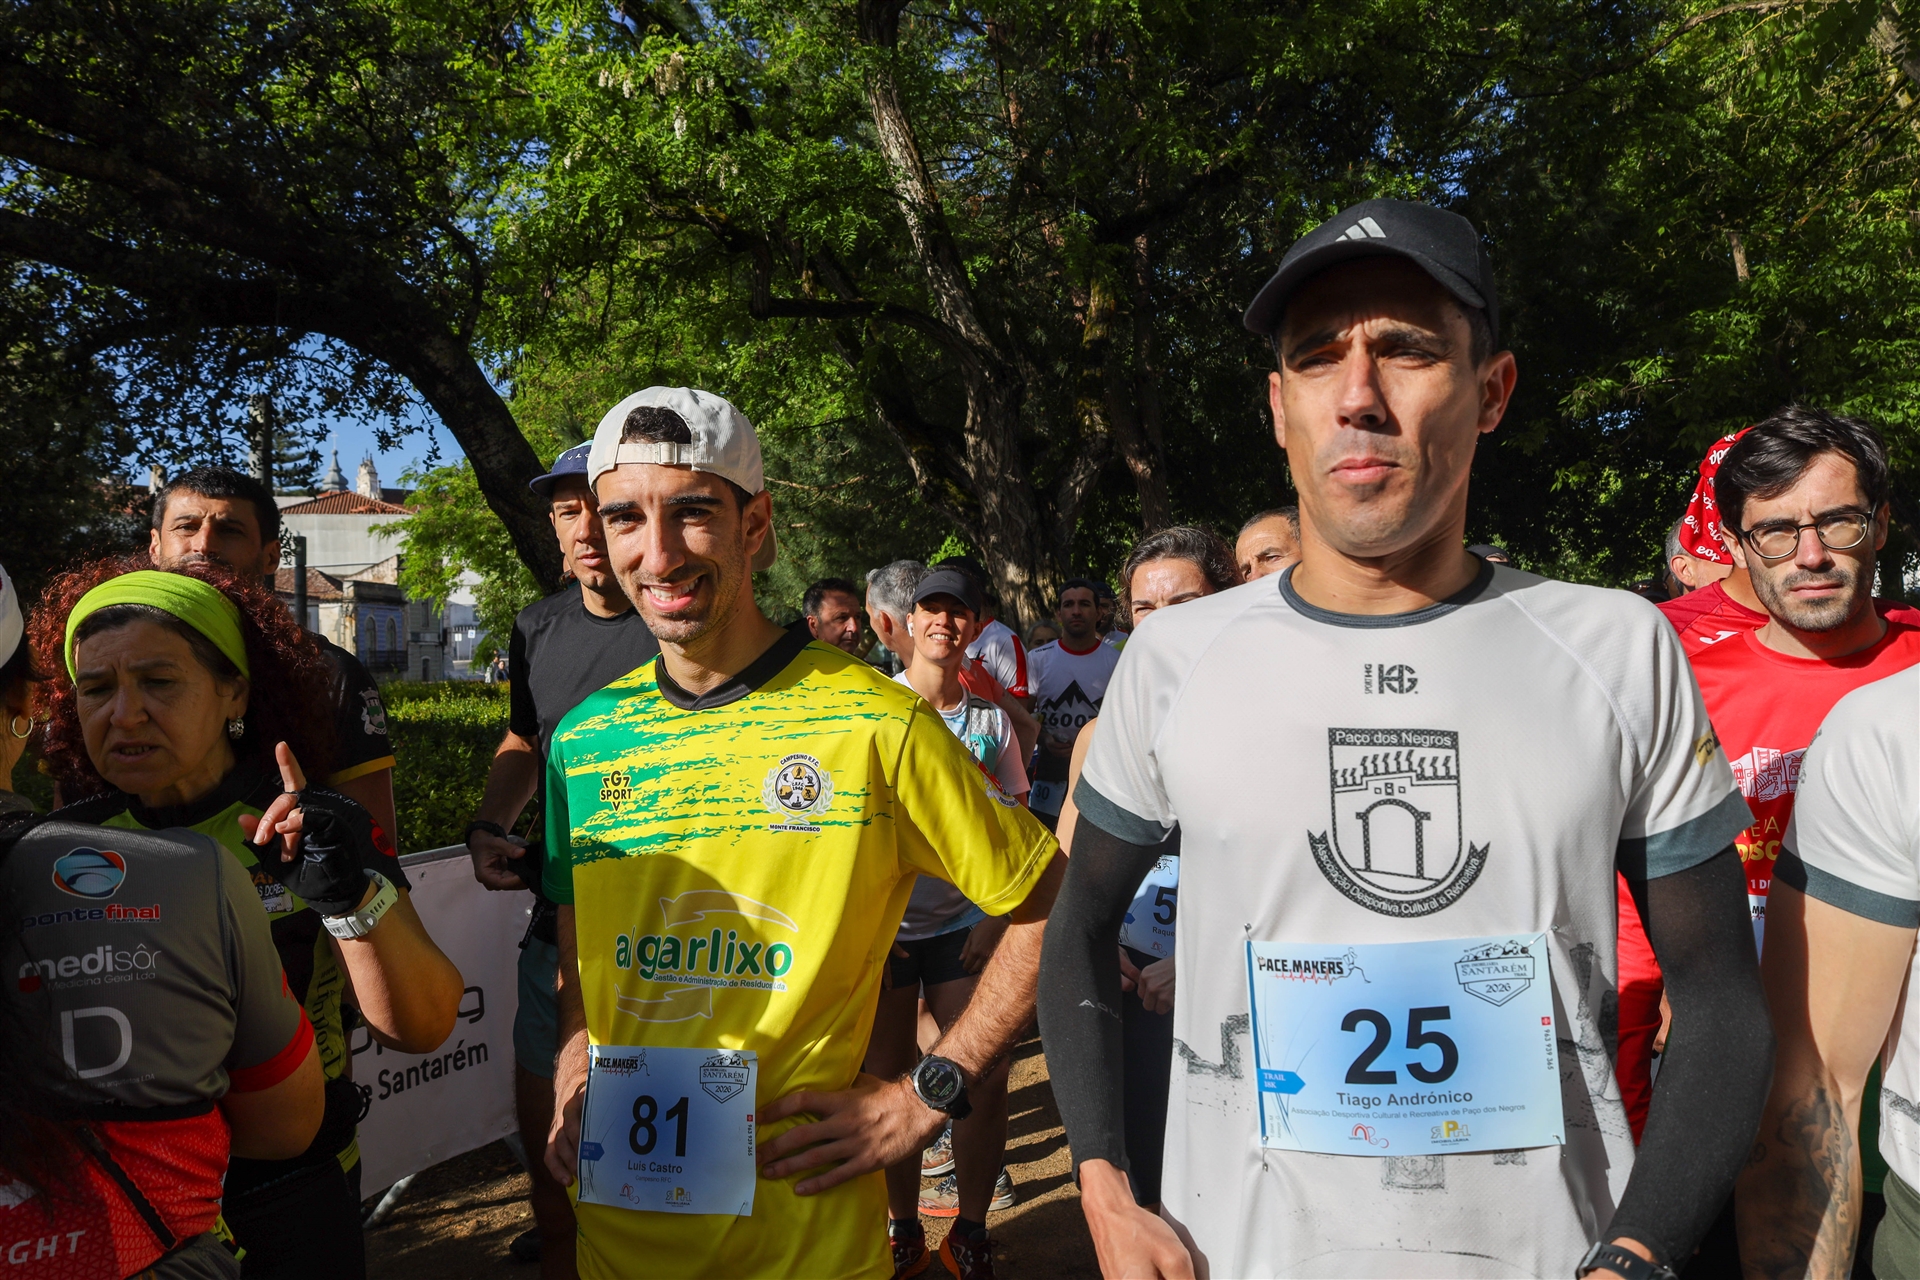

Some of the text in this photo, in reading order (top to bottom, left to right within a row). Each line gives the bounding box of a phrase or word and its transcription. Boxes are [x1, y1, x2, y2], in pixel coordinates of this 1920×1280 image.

[1336, 731, 1452, 747] Paço dos Negros
[600, 789, 633, 801] SPORT
[1035, 784, 1050, 800] 30
[789, 825, 821, 833] FRANCISCO
[1313, 843, 1351, 890] Associação
[1350, 885, 1399, 914] Desportiva
[1401, 898, 1439, 914] Cultural
[1443, 857, 1480, 900] Recreativa
[1462, 963, 1528, 977] SANTARÉM
[104, 973, 133, 984] Geral
[653, 973, 677, 983] Gestão
[729, 979, 739, 987] de
[740, 979, 773, 990] Resíduos
[1485, 983, 1511, 993] 2026
[1341, 1005, 1459, 1085] 25
[378, 1039, 489, 1101] Santarém
[703, 1071, 744, 1079] SANTARÉM
[1263, 1072, 1286, 1081] TRAIL
[715, 1085, 732, 1093] 2026
[1336, 1090, 1473, 1109] Tiago Andrónico
[1291, 1107, 1330, 1118] Associação
[1332, 1110, 1371, 1120] Desportiva
[1372, 1111, 1400, 1119] Cultural
[1409, 1109, 1449, 1118] Recreativa
[1451, 1108, 1460, 1116] de
[1462, 1107, 1481, 1116] Paço
[1483, 1105, 1497, 1113] dos
[1498, 1104, 1526, 1113] Negros
[628, 1095, 690, 1158] 81
[628, 1160, 683, 1174] Luis Castro
